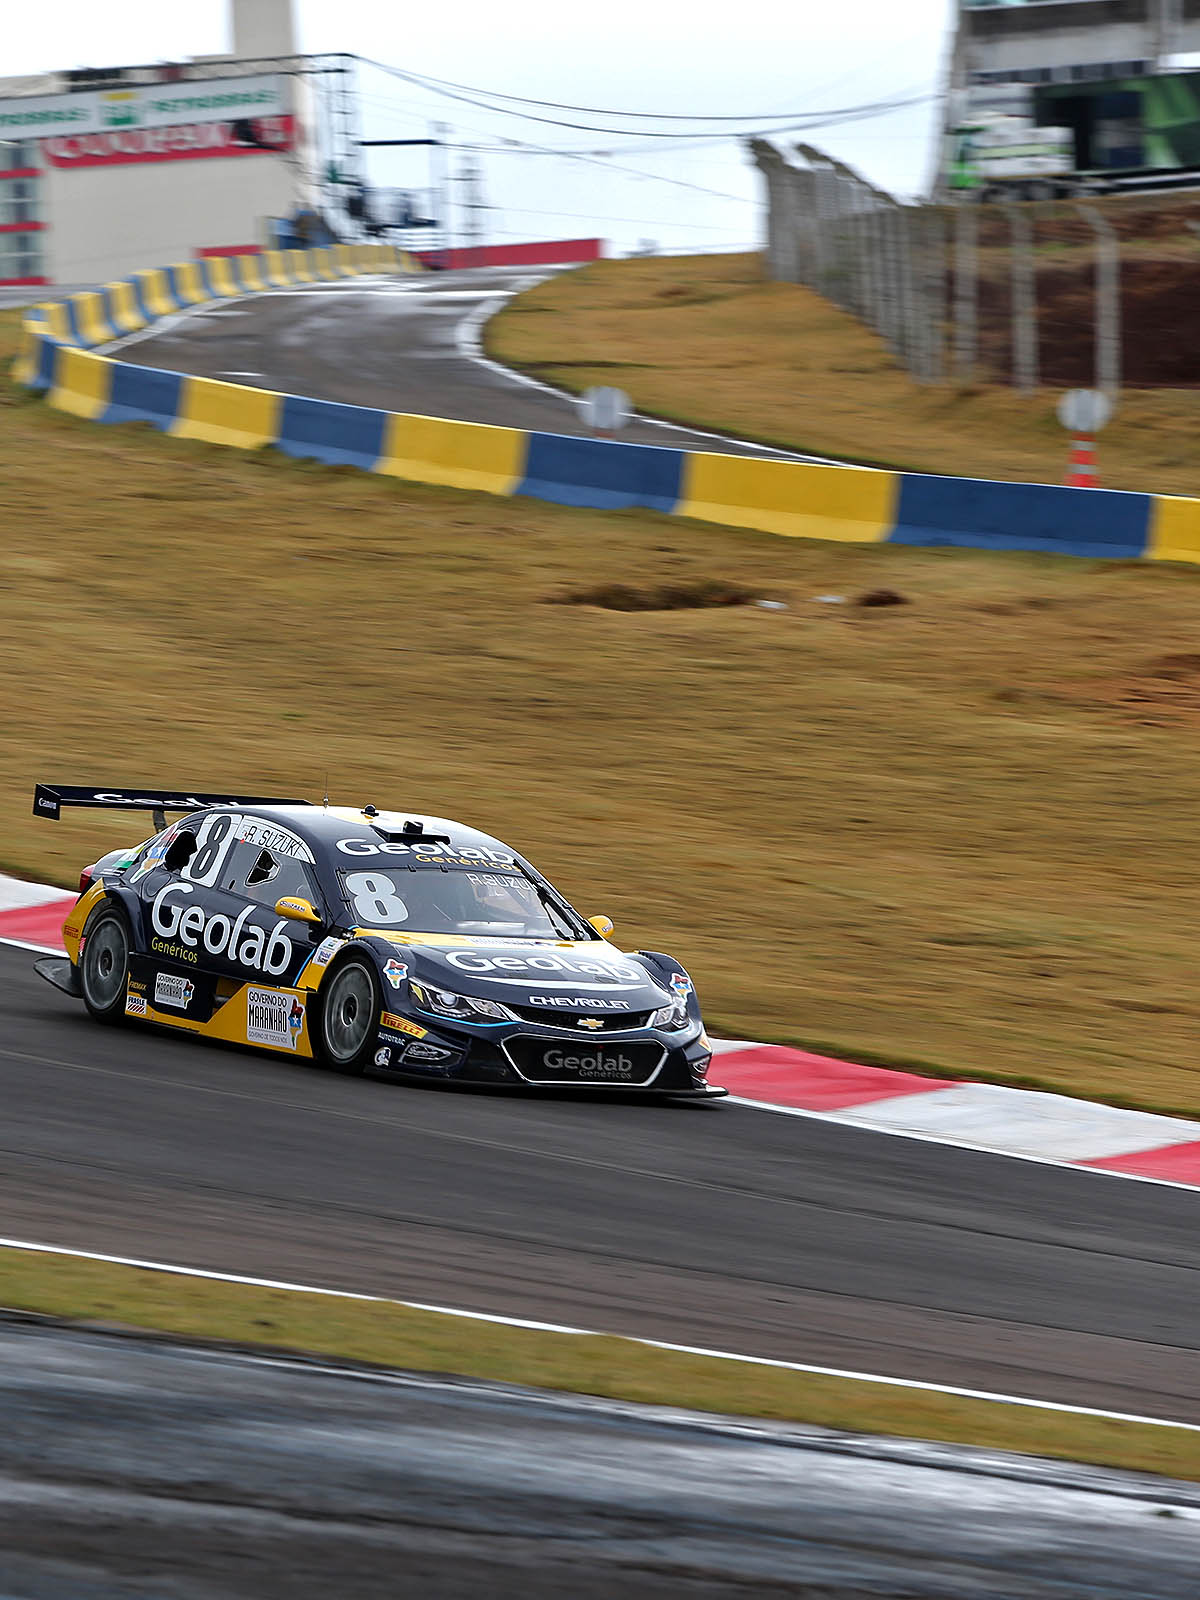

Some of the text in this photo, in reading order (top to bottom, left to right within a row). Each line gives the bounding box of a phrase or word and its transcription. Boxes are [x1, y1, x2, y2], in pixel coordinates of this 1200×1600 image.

[190, 815, 232, 880] 8
[259, 829, 303, 857] SUZUKI
[336, 838, 515, 865] Geolab
[345, 872, 409, 924] 8
[152, 882, 293, 976] Geolab
[151, 936, 198, 964] Genéricos
[445, 951, 641, 981] Geolab
[249, 991, 287, 1008] GOVERNO DO
[529, 996, 631, 1010] CHEVROLET
[248, 1004, 287, 1033] MARANHÃO
[383, 1013, 423, 1036] PIRELLI
[378, 1032, 406, 1046] AUTOTRAC
[543, 1050, 633, 1072] Geolab
